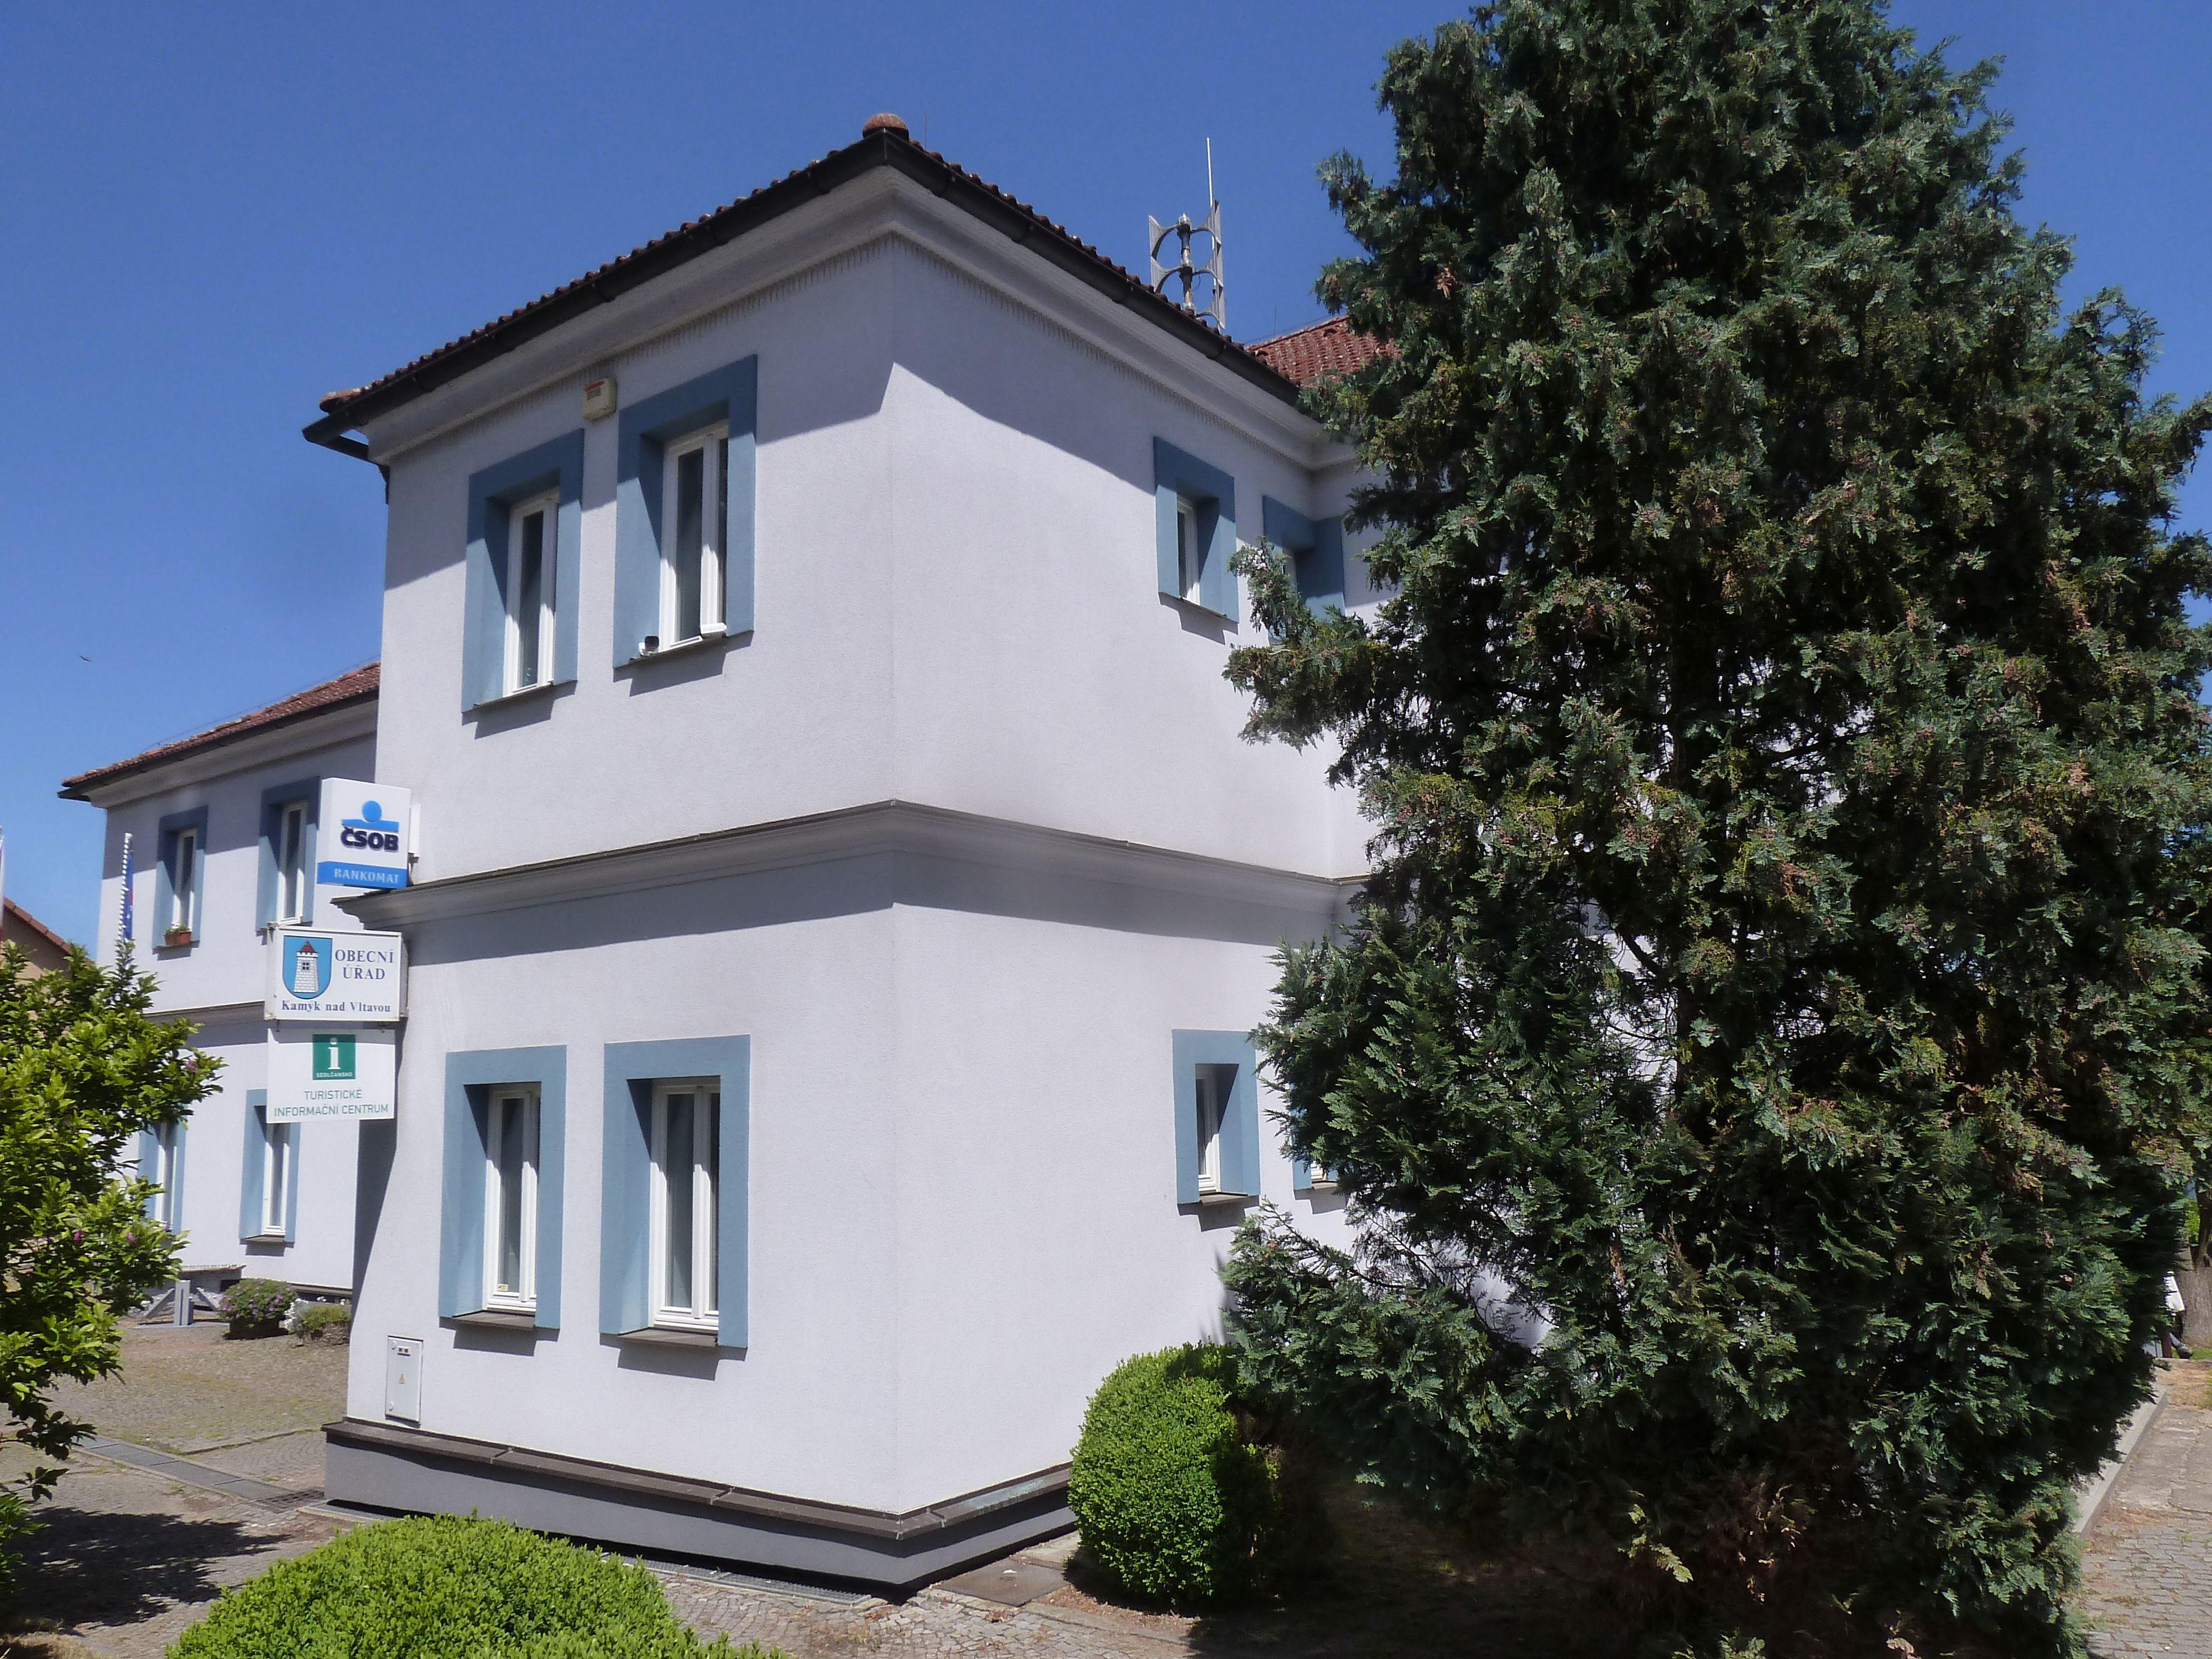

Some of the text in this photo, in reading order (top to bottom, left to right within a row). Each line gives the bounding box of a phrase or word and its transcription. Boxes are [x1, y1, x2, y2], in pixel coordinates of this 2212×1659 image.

[341, 827, 399, 852] ČSOB
[334, 867, 399, 884] BANKOMAT
[335, 949, 394, 963] OBECNÍ
[343, 964, 385, 979] ÚŘAD
[282, 1000, 390, 1013] Kamýk nad Vltavou
[304, 1088, 362, 1100] TURISTICKÉ
[274, 1103, 389, 1117] INFORMAČNÍ CENTRUM
